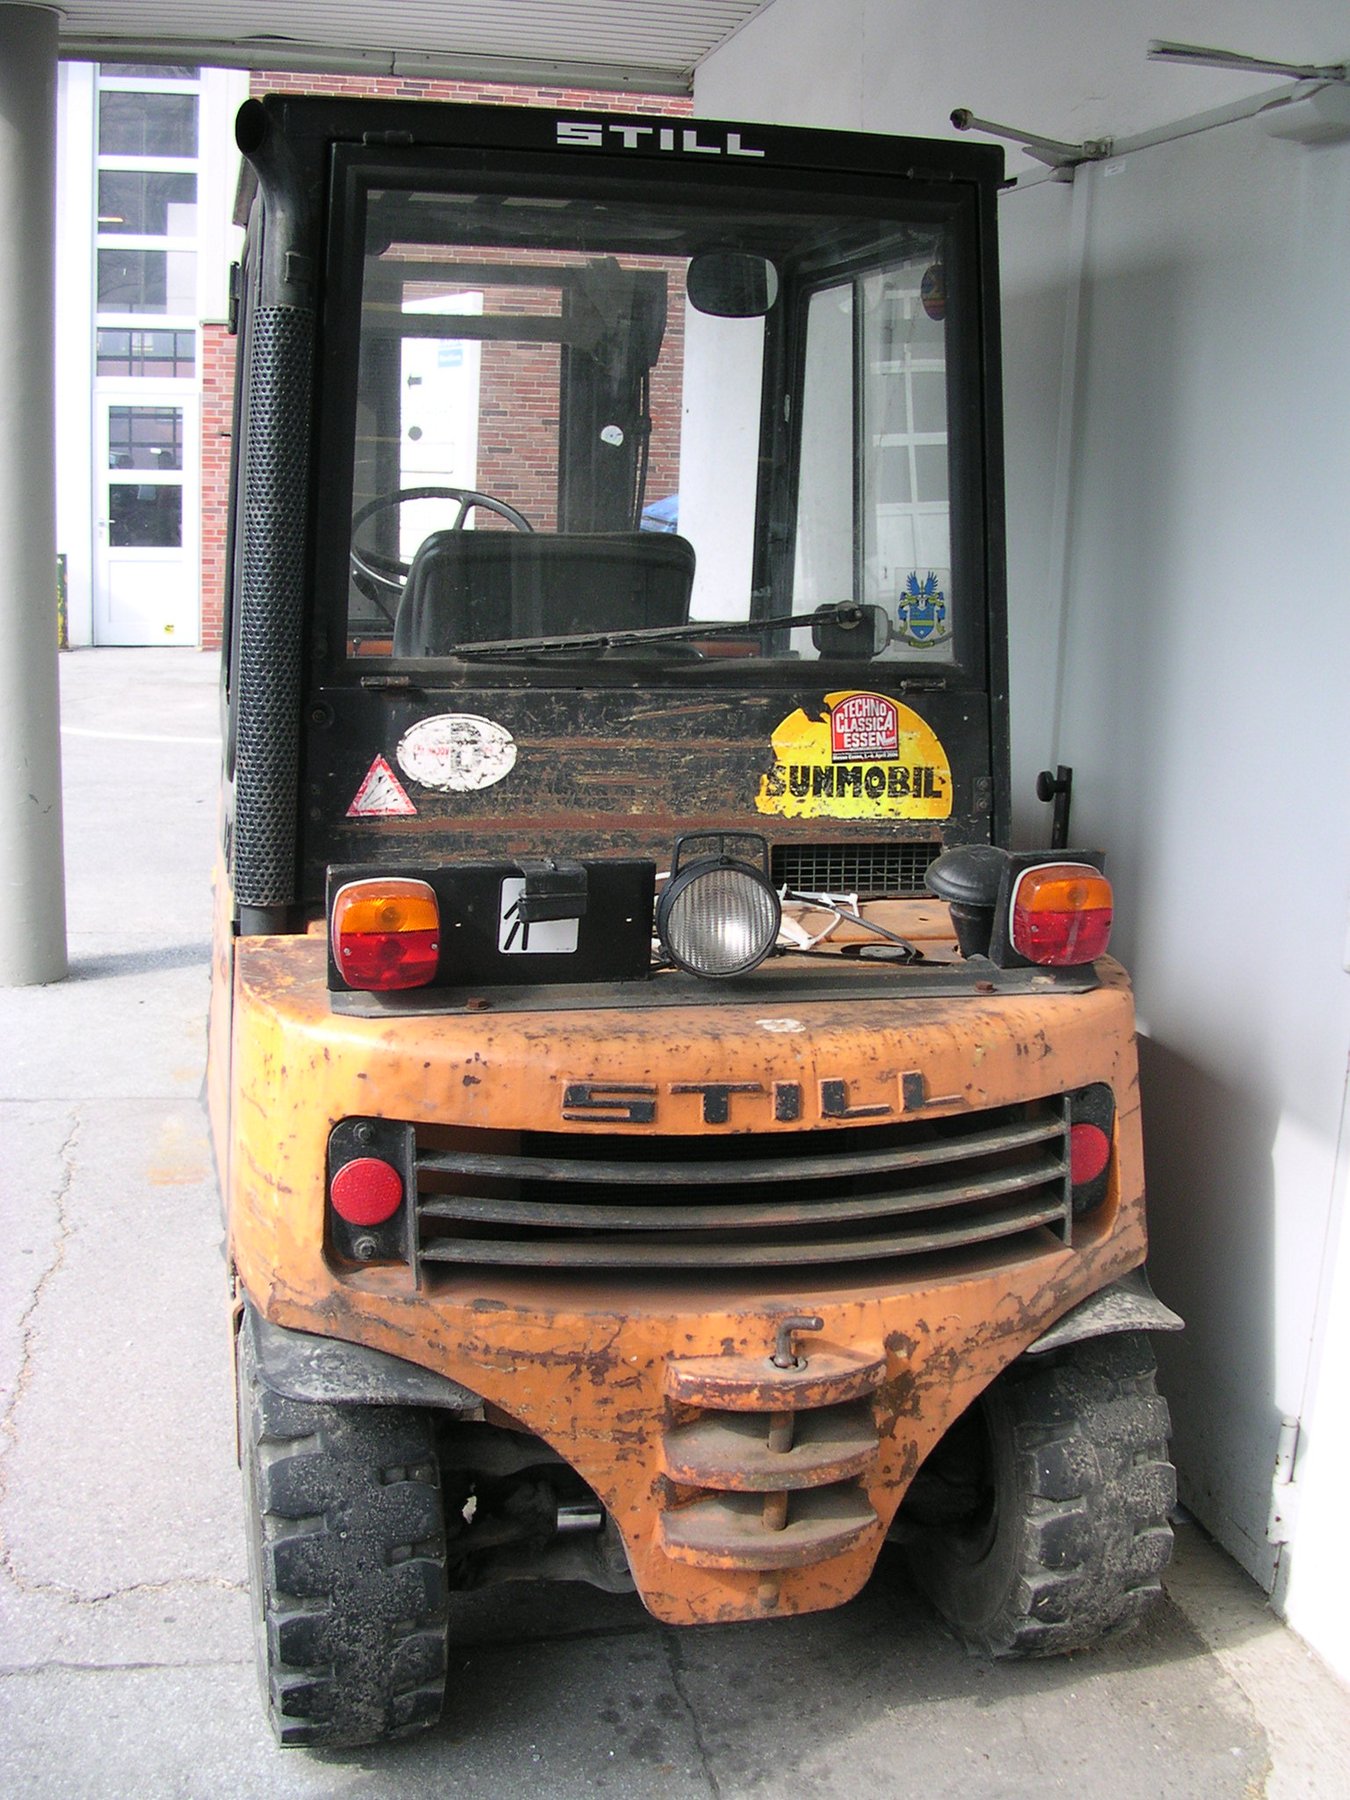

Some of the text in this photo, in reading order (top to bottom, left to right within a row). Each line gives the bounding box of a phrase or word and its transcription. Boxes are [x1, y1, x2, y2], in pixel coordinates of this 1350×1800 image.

[557, 122, 765, 157] STILL
[835, 711, 893, 733] CLASSICA
[842, 698, 887, 718] TECHNO
[843, 731, 888, 748] ESSEN
[765, 765, 943, 799] SUNMOBIL
[562, 1069, 968, 1124] STILL
